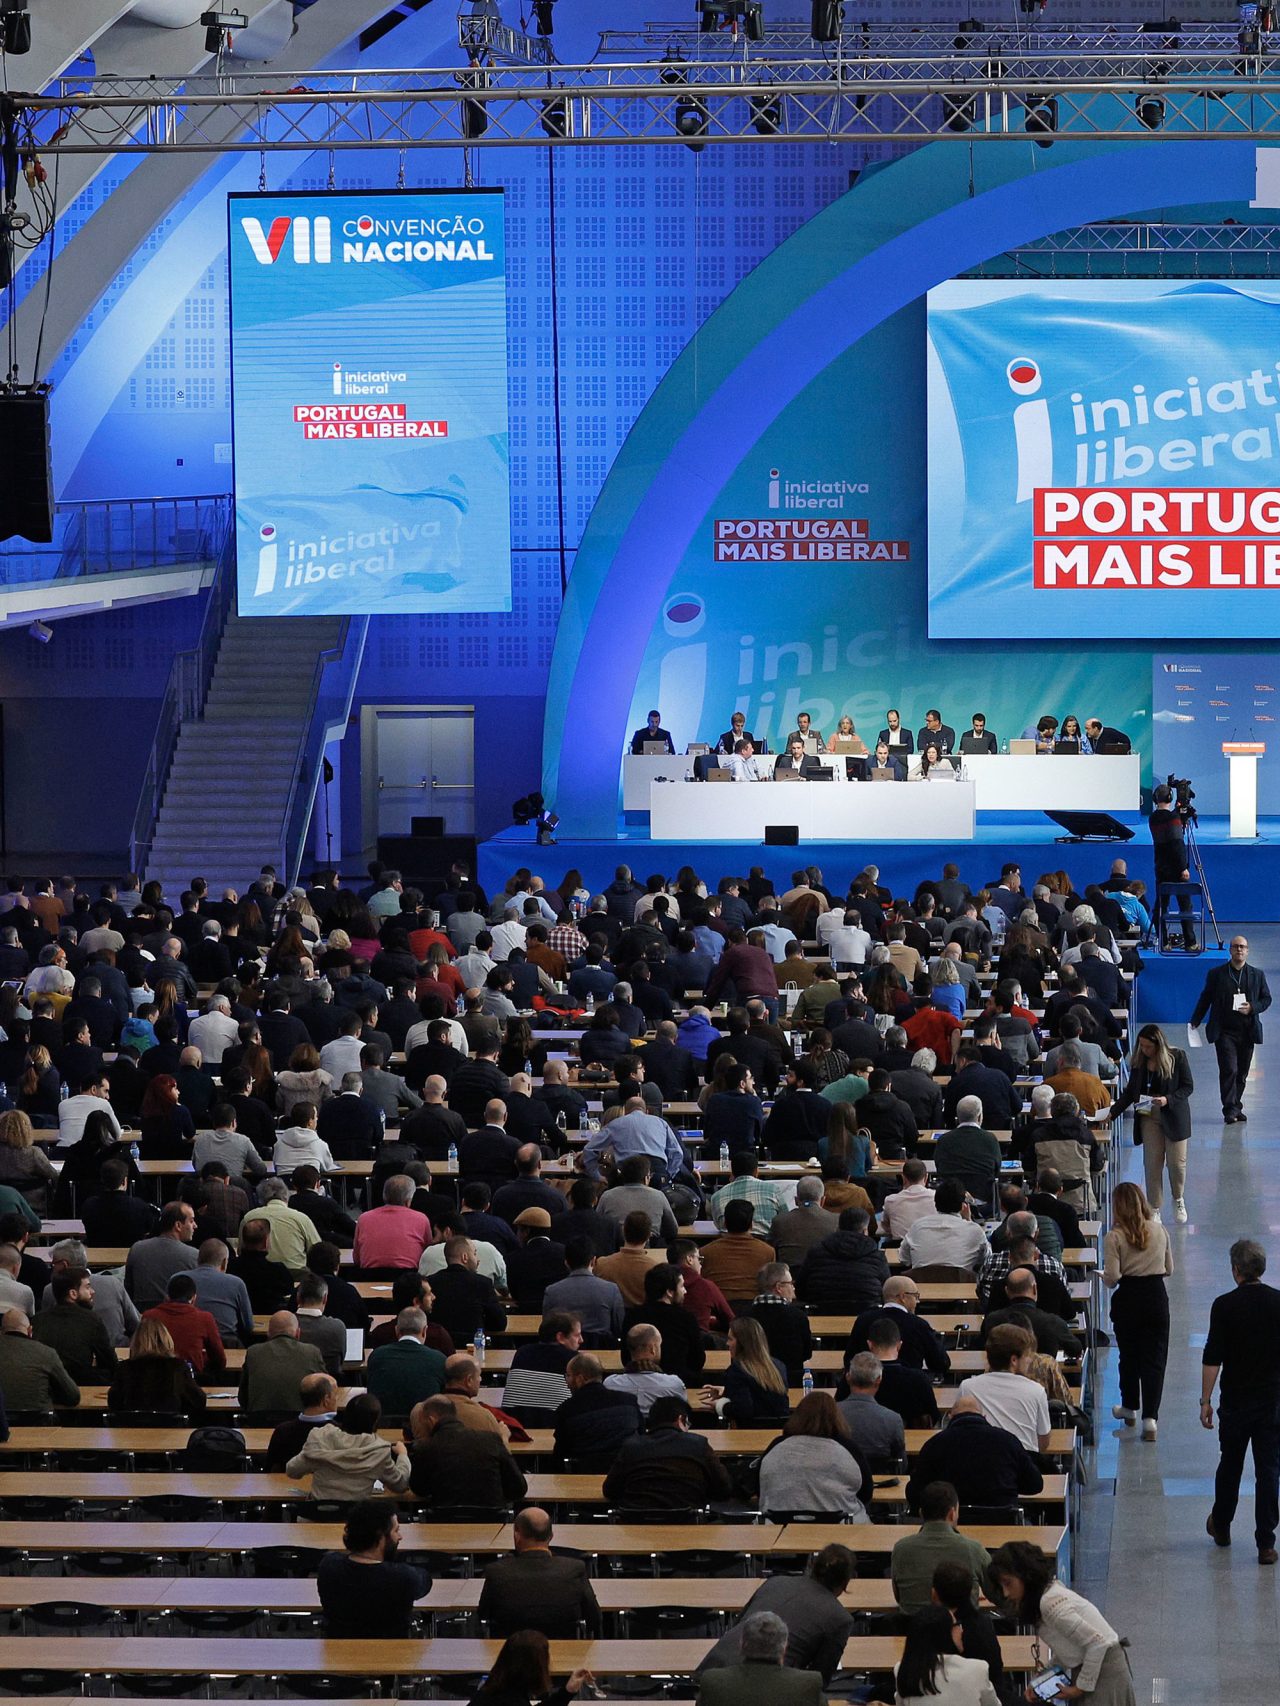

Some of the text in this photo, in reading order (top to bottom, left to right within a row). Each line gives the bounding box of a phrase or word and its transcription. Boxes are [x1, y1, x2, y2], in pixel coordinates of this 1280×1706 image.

[343, 215, 484, 239] CONVENÇÃO
[241, 216, 331, 264] VII
[343, 240, 494, 262] NACIONAL
[345, 371, 407, 382] iniciativa
[345, 383, 389, 394] liberal
[297, 406, 404, 421] PORTUGAL
[307, 422, 445, 438] MAIS LIBERAL
[785, 480, 869, 494] iniciativa
[785, 495, 844, 509] liberal
[718, 521, 866, 539] PORTUGAL
[288, 519, 442, 562] iniciativa
[718, 543, 907, 561] MAIS LIBERAL
[284, 550, 395, 589] liberal
[1044, 544, 1194, 586] MAIS
